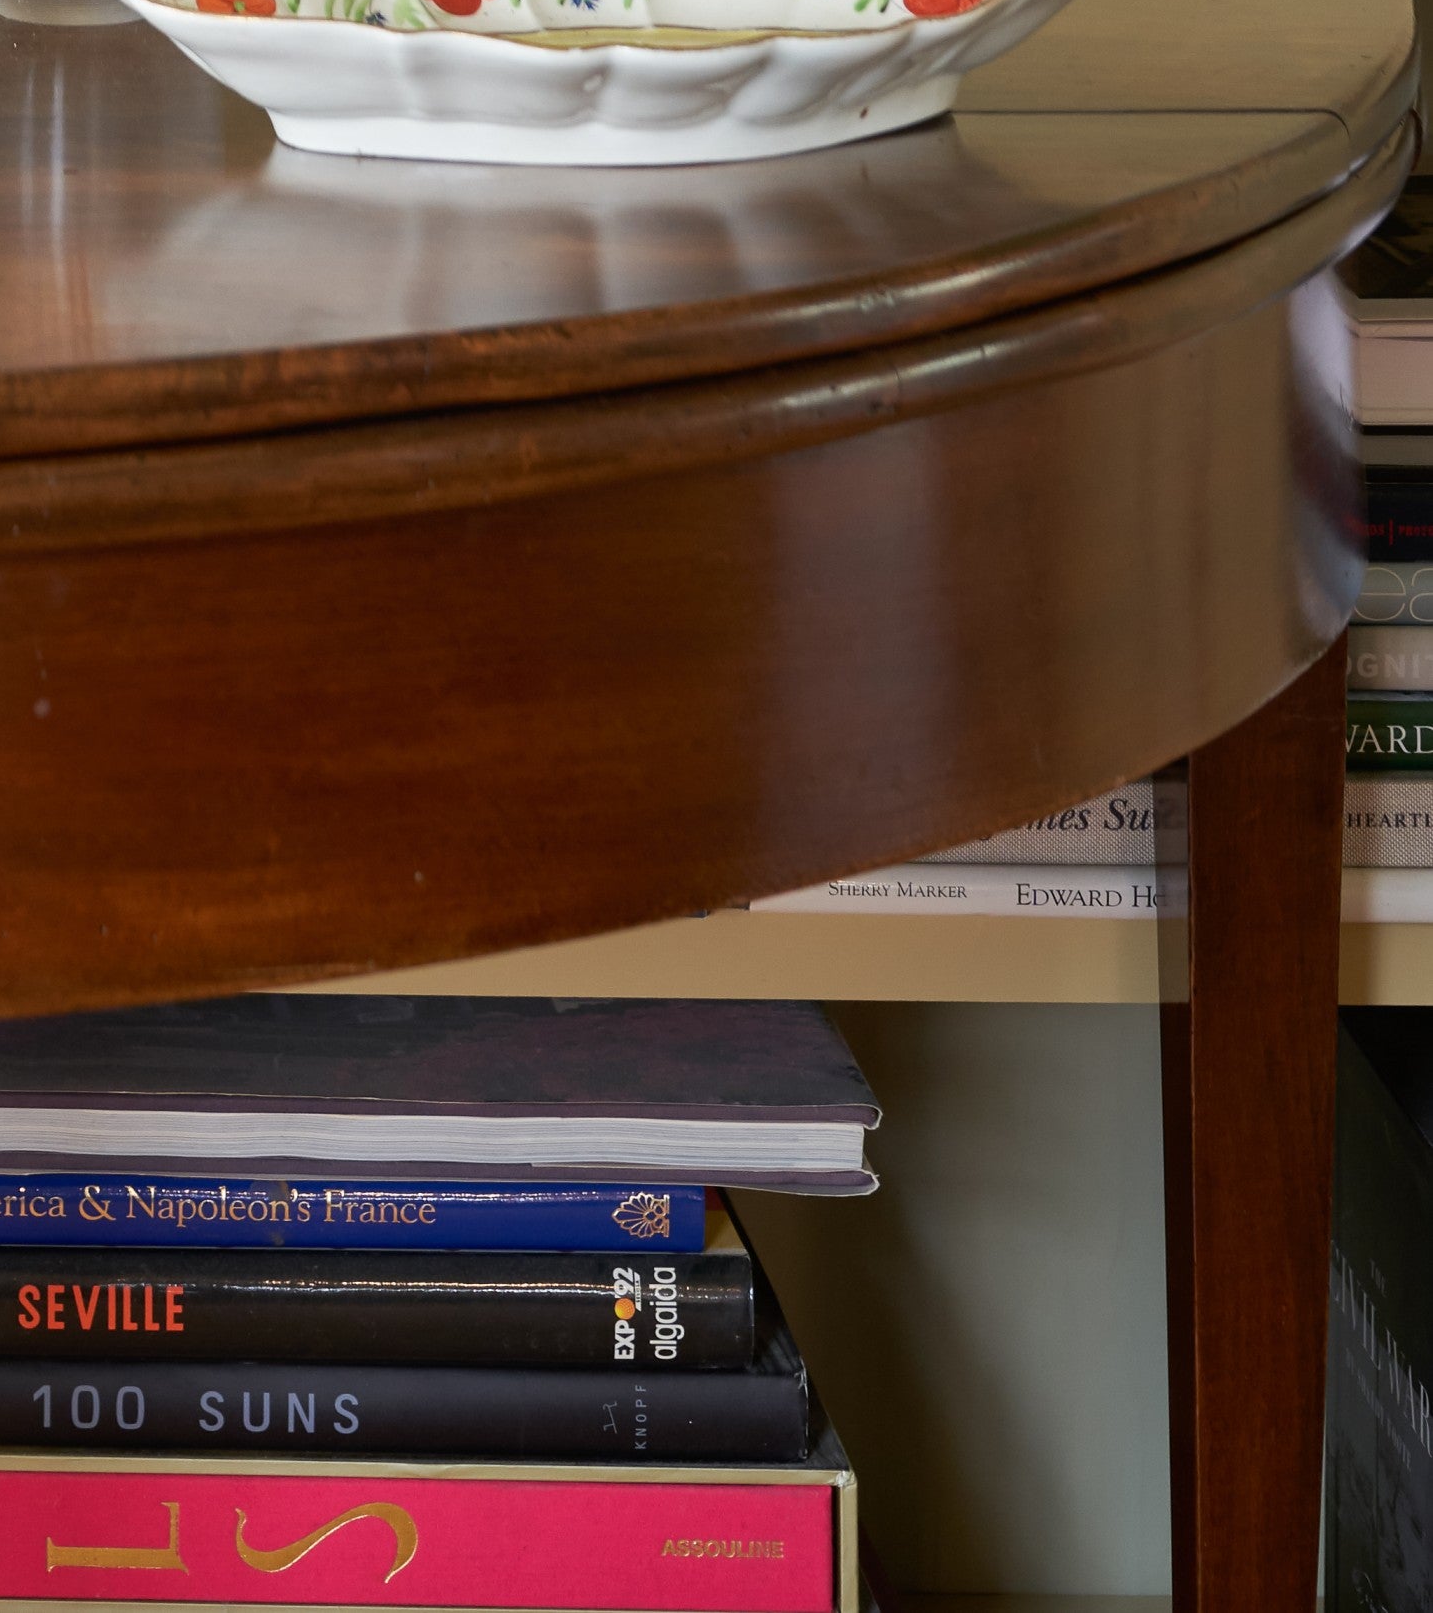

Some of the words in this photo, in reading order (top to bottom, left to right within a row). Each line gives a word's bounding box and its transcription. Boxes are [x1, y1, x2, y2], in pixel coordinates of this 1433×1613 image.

[828, 879, 891, 898] SHERRY
[897, 882, 967, 899] MARKER
[1016, 884, 1122, 907] EDWARD
[79, 1188, 114, 1222] &
[126, 1187, 311, 1229] Napoleon's
[323, 1190, 437, 1229] France
[18, 1284, 184, 1331] SEVILLE
[32, 1385, 147, 1432] 100
[199, 1390, 361, 1434] SUNS
[661, 1539, 785, 1560] ASSOULINE
